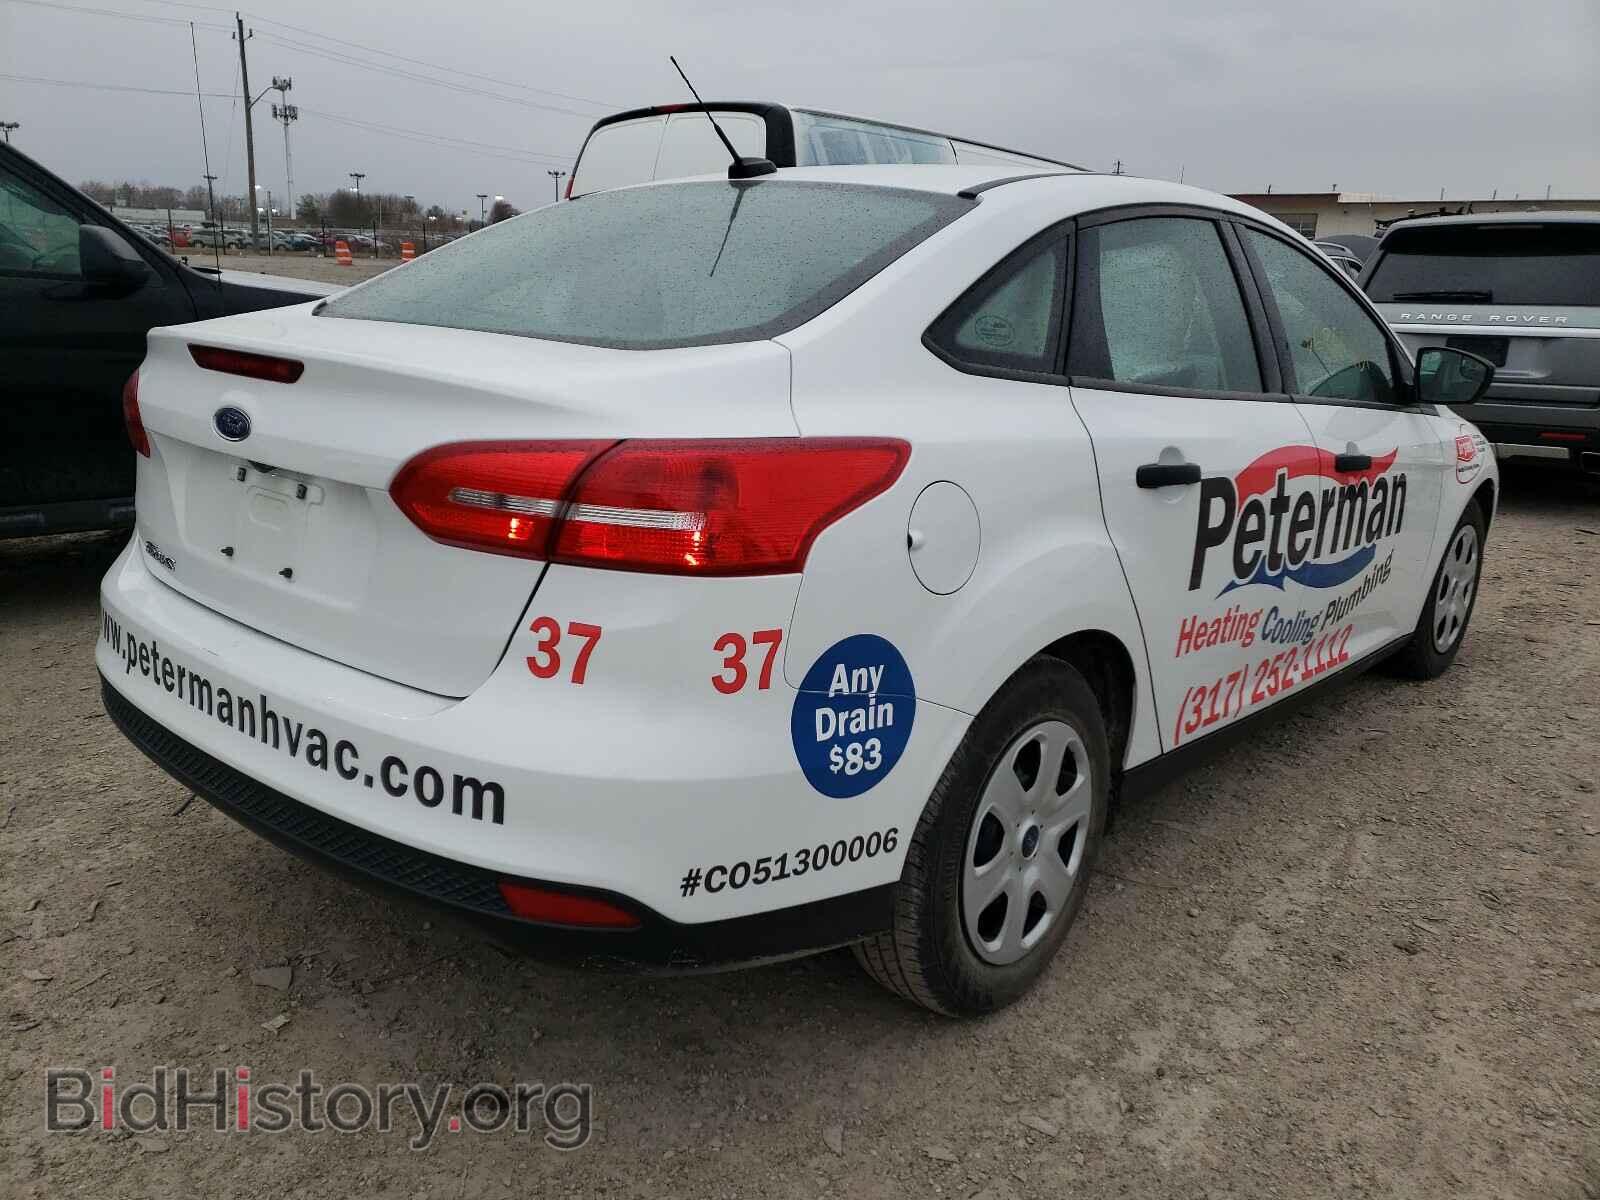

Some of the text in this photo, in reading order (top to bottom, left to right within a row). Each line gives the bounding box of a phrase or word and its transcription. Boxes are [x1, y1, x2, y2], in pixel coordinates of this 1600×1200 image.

[1401, 313, 1568, 323] RANGE ROVER
[1188, 473, 1406, 590] Peterman
[1176, 548, 1394, 657] Heating Cooling Plumbing
[526, 616, 602, 684] 37
[711, 629, 782, 694] 37
[828, 663, 884, 698] Any
[815, 693, 893, 741] Drain
[1174, 624, 1352, 745] (317) 252-1112
[829, 738, 882, 775] $83
